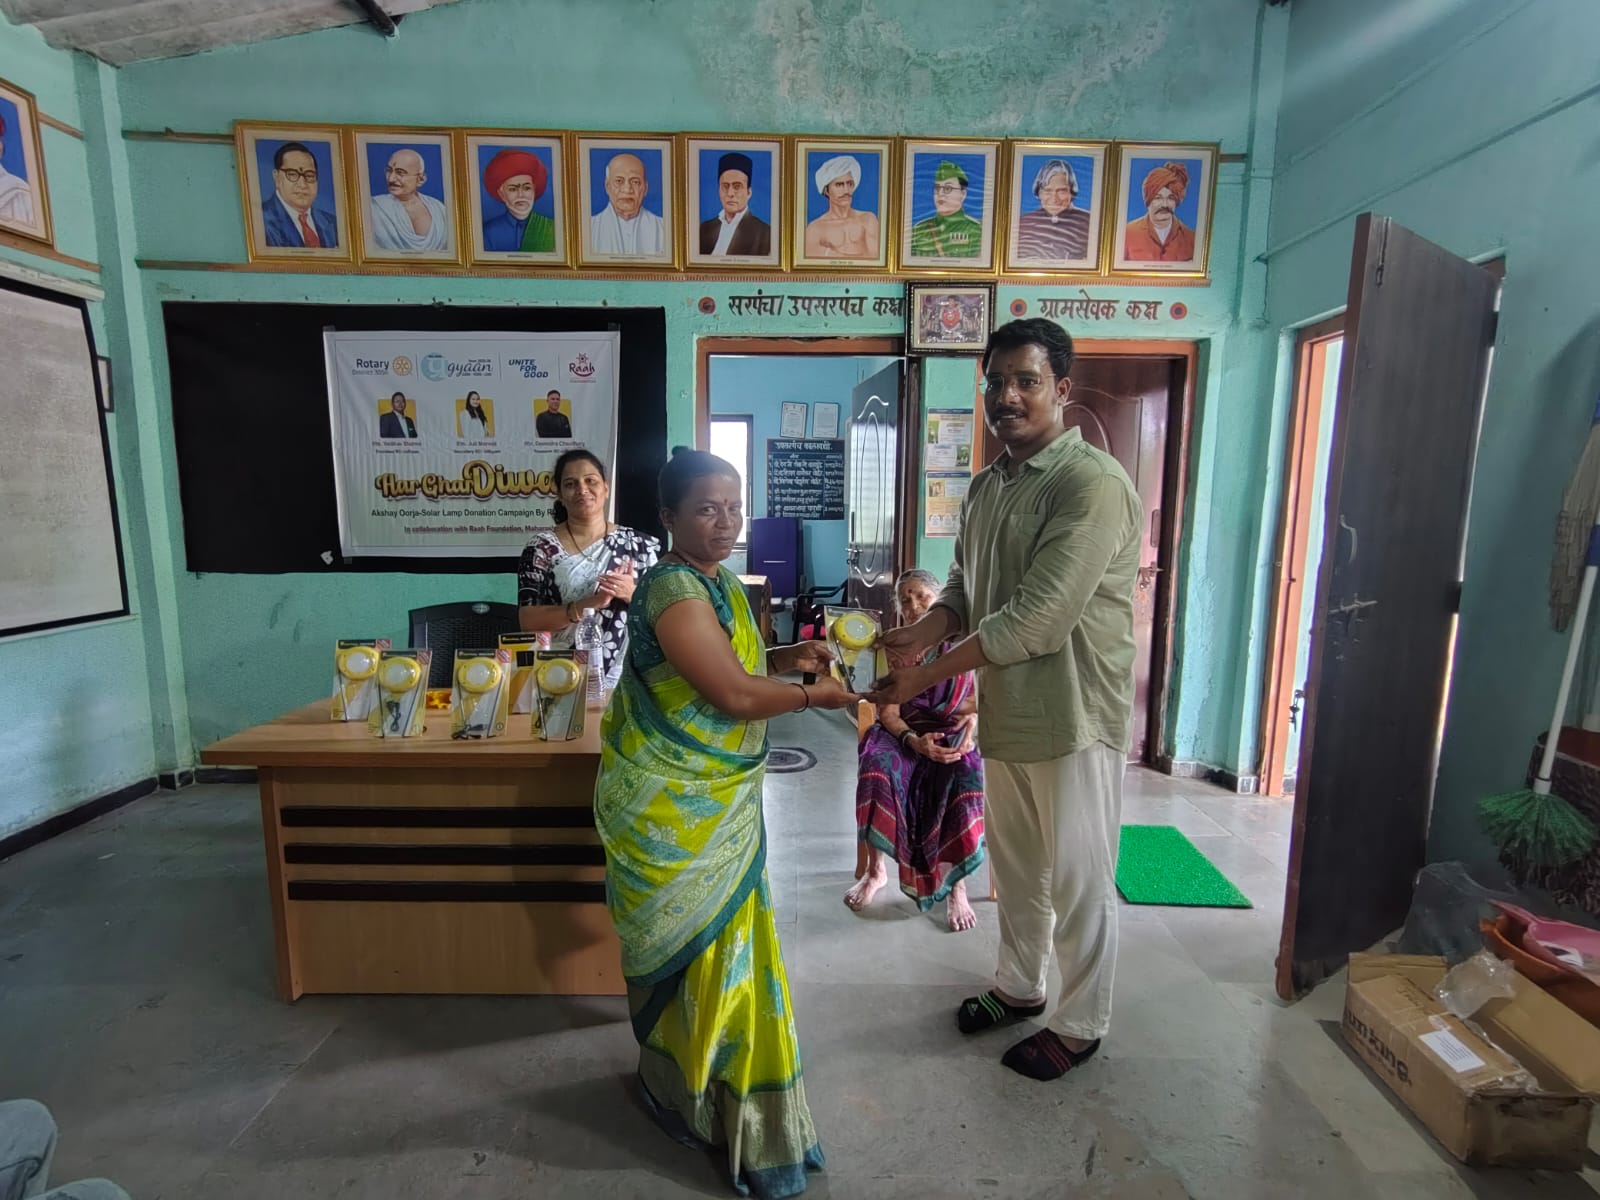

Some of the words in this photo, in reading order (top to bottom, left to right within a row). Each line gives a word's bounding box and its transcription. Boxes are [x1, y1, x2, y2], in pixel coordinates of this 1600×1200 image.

[787, 288, 868, 317] उपसरपंच
[873, 296, 905, 317] कक्ष
[1037, 288, 1120, 320] ग्रामसेवक
[1126, 300, 1163, 320] कक्ष
[356, 358, 390, 370] Rotary
[375, 472, 420, 499] Har
[420, 473, 474, 501] Ghar
[462, 459, 556, 501] Diwa
[371, 508, 398, 519] Akshay
[399, 508, 441, 519] Oorja-Solar
[442, 508, 463, 518] Lamp
[464, 508, 497, 517] Donation
[497, 508, 534, 519] Campaign
[536, 508, 546, 518] By
